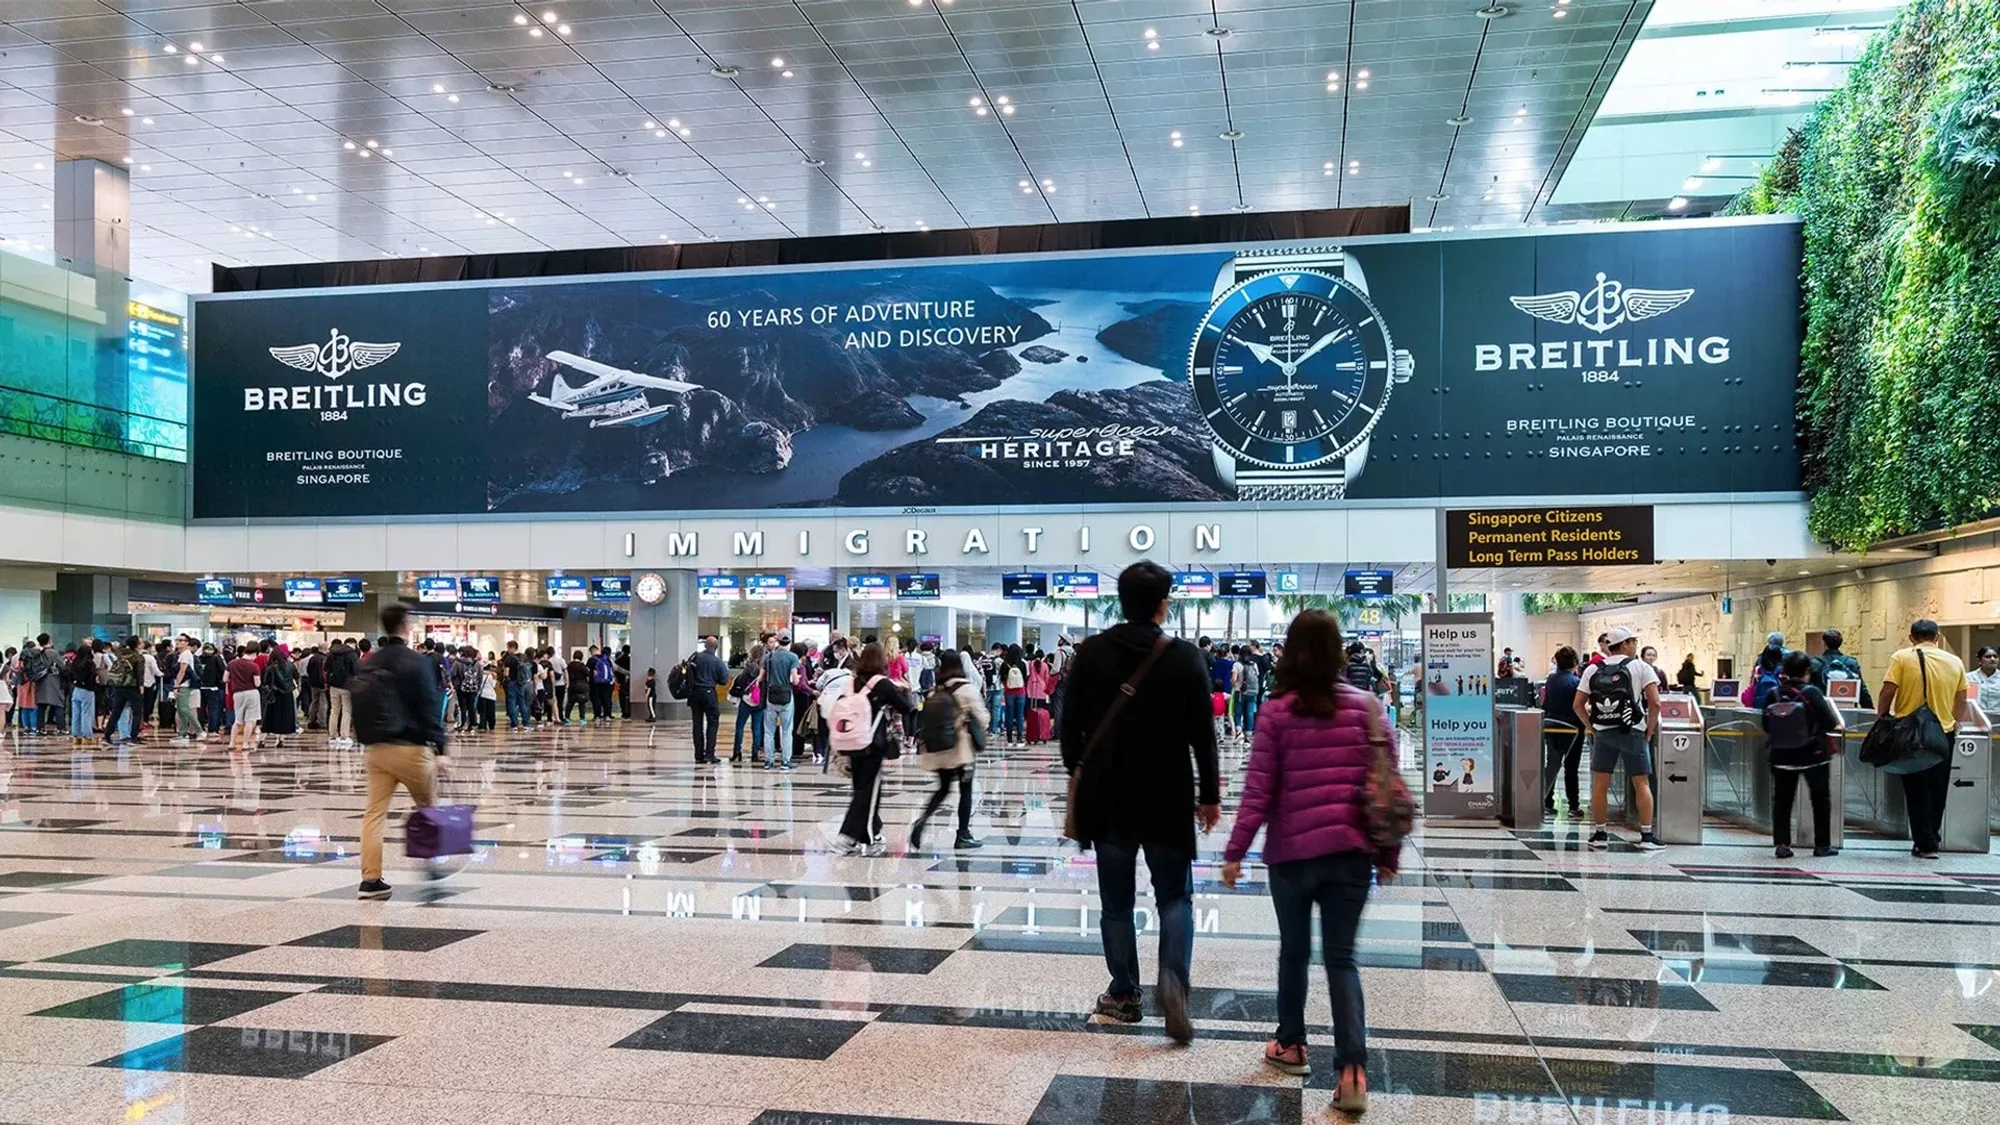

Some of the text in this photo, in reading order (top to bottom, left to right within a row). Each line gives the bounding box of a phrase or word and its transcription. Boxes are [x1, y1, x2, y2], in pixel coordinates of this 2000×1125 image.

[708, 300, 974, 328] 60 YEARS OF ADVENTURE
[845, 326, 1021, 349] AND DISCOVERY
[1476, 337, 1729, 370] BREITLING
[1582, 371, 1619, 382] 1884
[245, 383, 426, 410] BREITLING
[321, 411, 347, 421] 1884
[1507, 416, 1695, 430] BREITLING BOUTIQUE
[267, 449, 402, 461] BREITLING BOUTIQUE
[1550, 446, 1650, 457] SINGAPORE
[1024, 460, 1059, 468] SINCE
[297, 474, 370, 484] SINGAPORE
[1469, 510, 1602, 527] Singapore Citizens
[625, 524, 1221, 556] IMMIGRATION
[1470, 529, 1621, 543] Permanent Residents
[1470, 547, 1638, 565] Long Term Pass Holders
[1358, 609, 1380, 624] 48
[1429, 629, 1458, 641] Help
[1431, 719, 1487, 732] Help you
[1675, 738, 1687, 747] 17
[1961, 742, 1975, 752] 19
